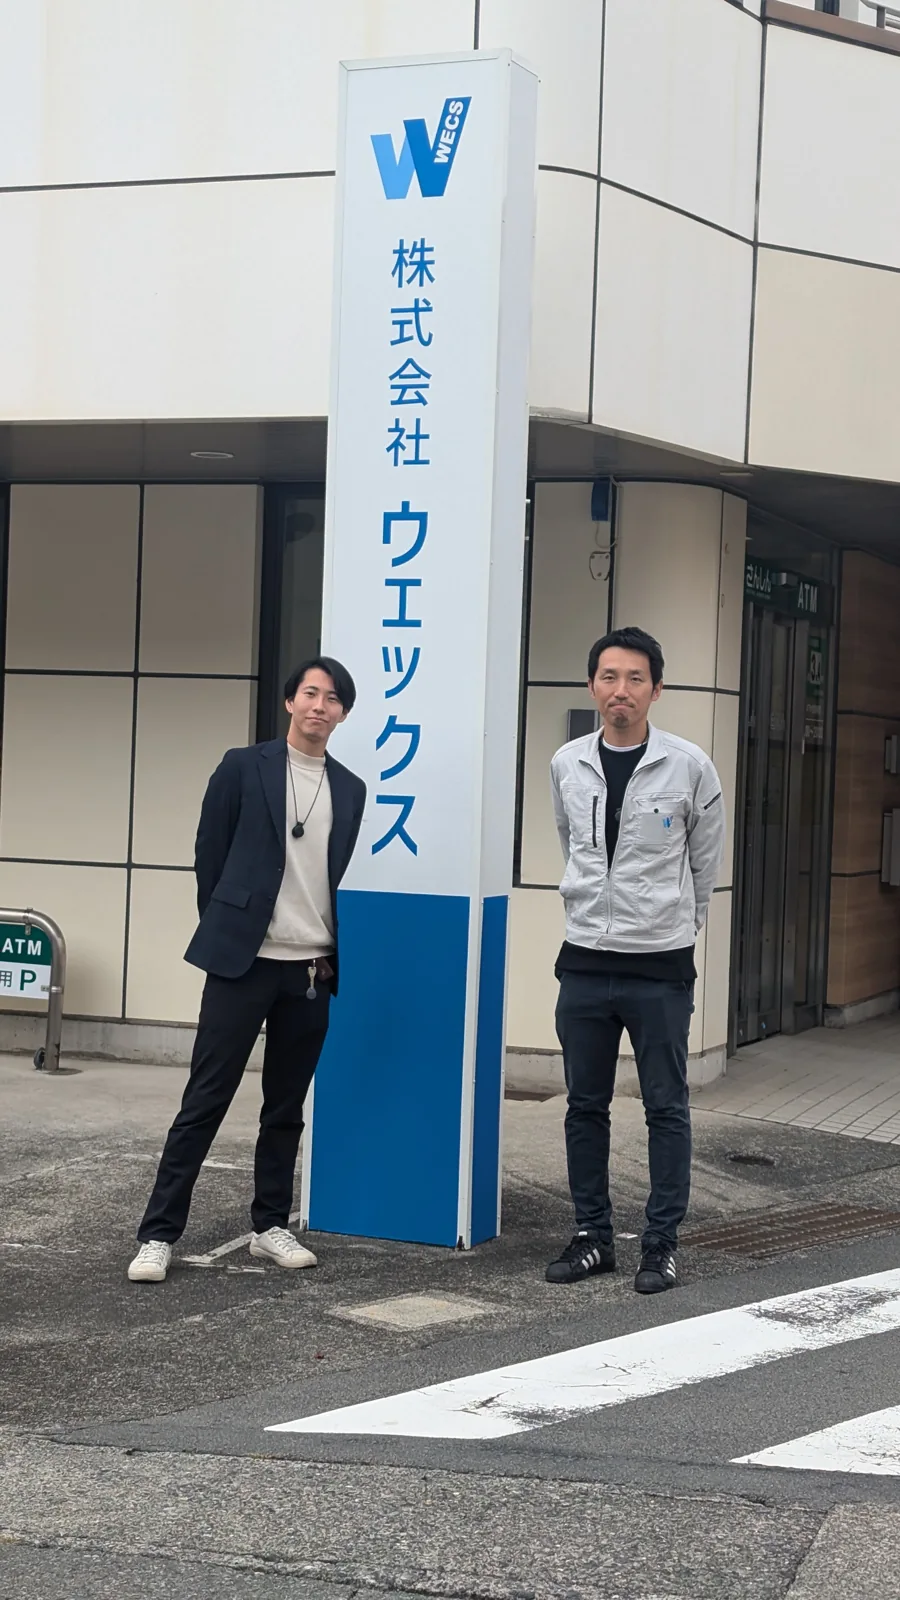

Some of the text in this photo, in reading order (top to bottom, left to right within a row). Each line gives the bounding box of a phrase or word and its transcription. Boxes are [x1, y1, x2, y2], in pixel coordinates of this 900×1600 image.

[434, 100, 464, 163] WECS
[386, 237, 435, 467] 株式会社
[746, 564, 772, 593] さんしん
[797, 581, 818, 613] ATM
[2, 938, 42, 956] ATM
[20, 969, 37, 991] P
